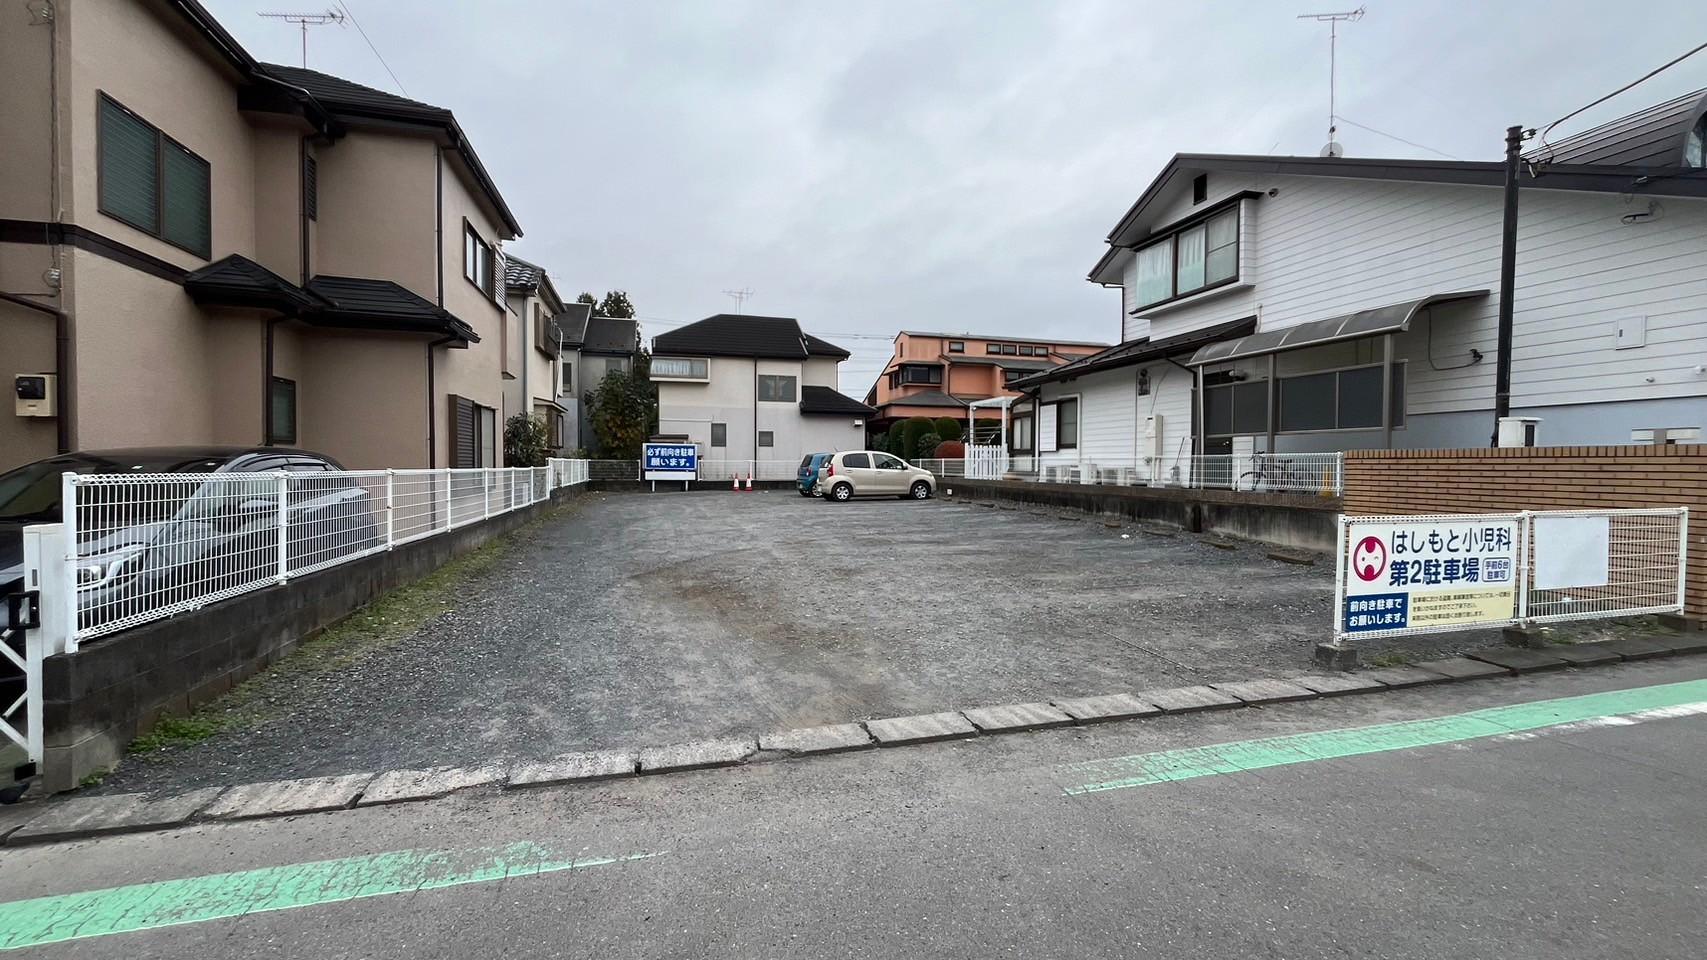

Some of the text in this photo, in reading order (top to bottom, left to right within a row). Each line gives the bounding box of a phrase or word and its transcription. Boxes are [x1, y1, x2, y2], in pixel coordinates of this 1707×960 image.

[1391, 527, 1512, 554] はしもと小児科
[1389, 557, 1479, 587] 第2駐車場
[1350, 598, 1403, 612] 前向き駐車で
[1349, 612, 1406, 627] お願いします。
